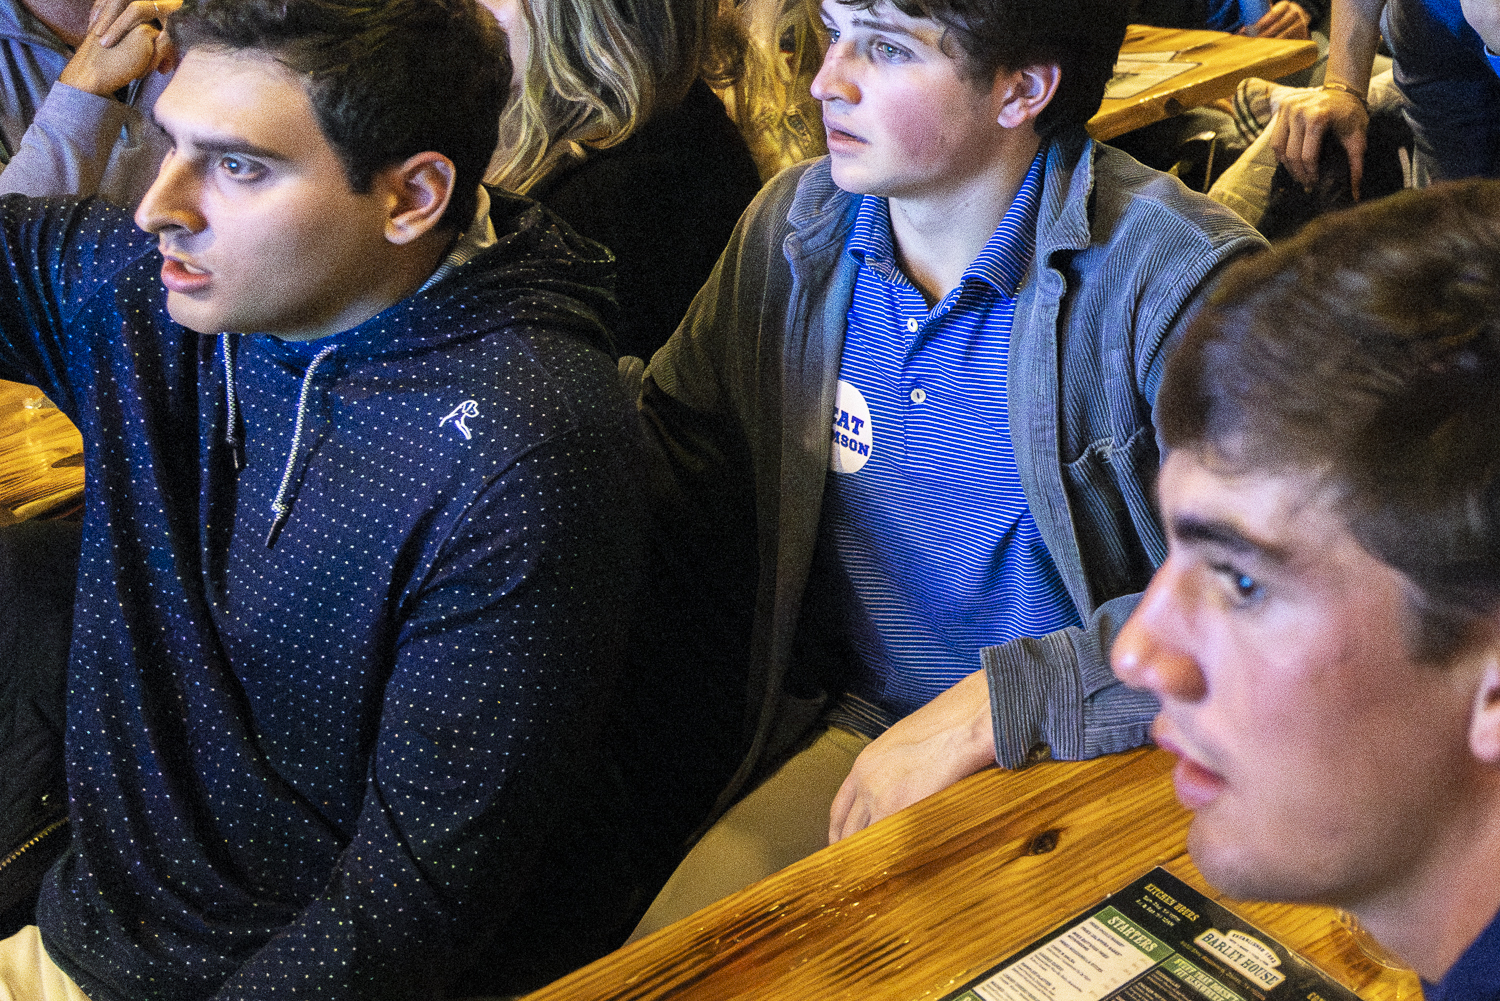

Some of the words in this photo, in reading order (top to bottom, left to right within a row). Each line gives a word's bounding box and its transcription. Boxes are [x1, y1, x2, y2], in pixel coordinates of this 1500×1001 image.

[833, 406, 864, 435] EAT
[832, 430, 870, 457] MSON
[1144, 883, 1178, 906] KITCHEN
[1173, 902, 1200, 922] HOURS
[1107, 915, 1158, 952] STARTERS
[1201, 933, 1244, 962] BARLEY
[1240, 959, 1280, 985] HOUSE
